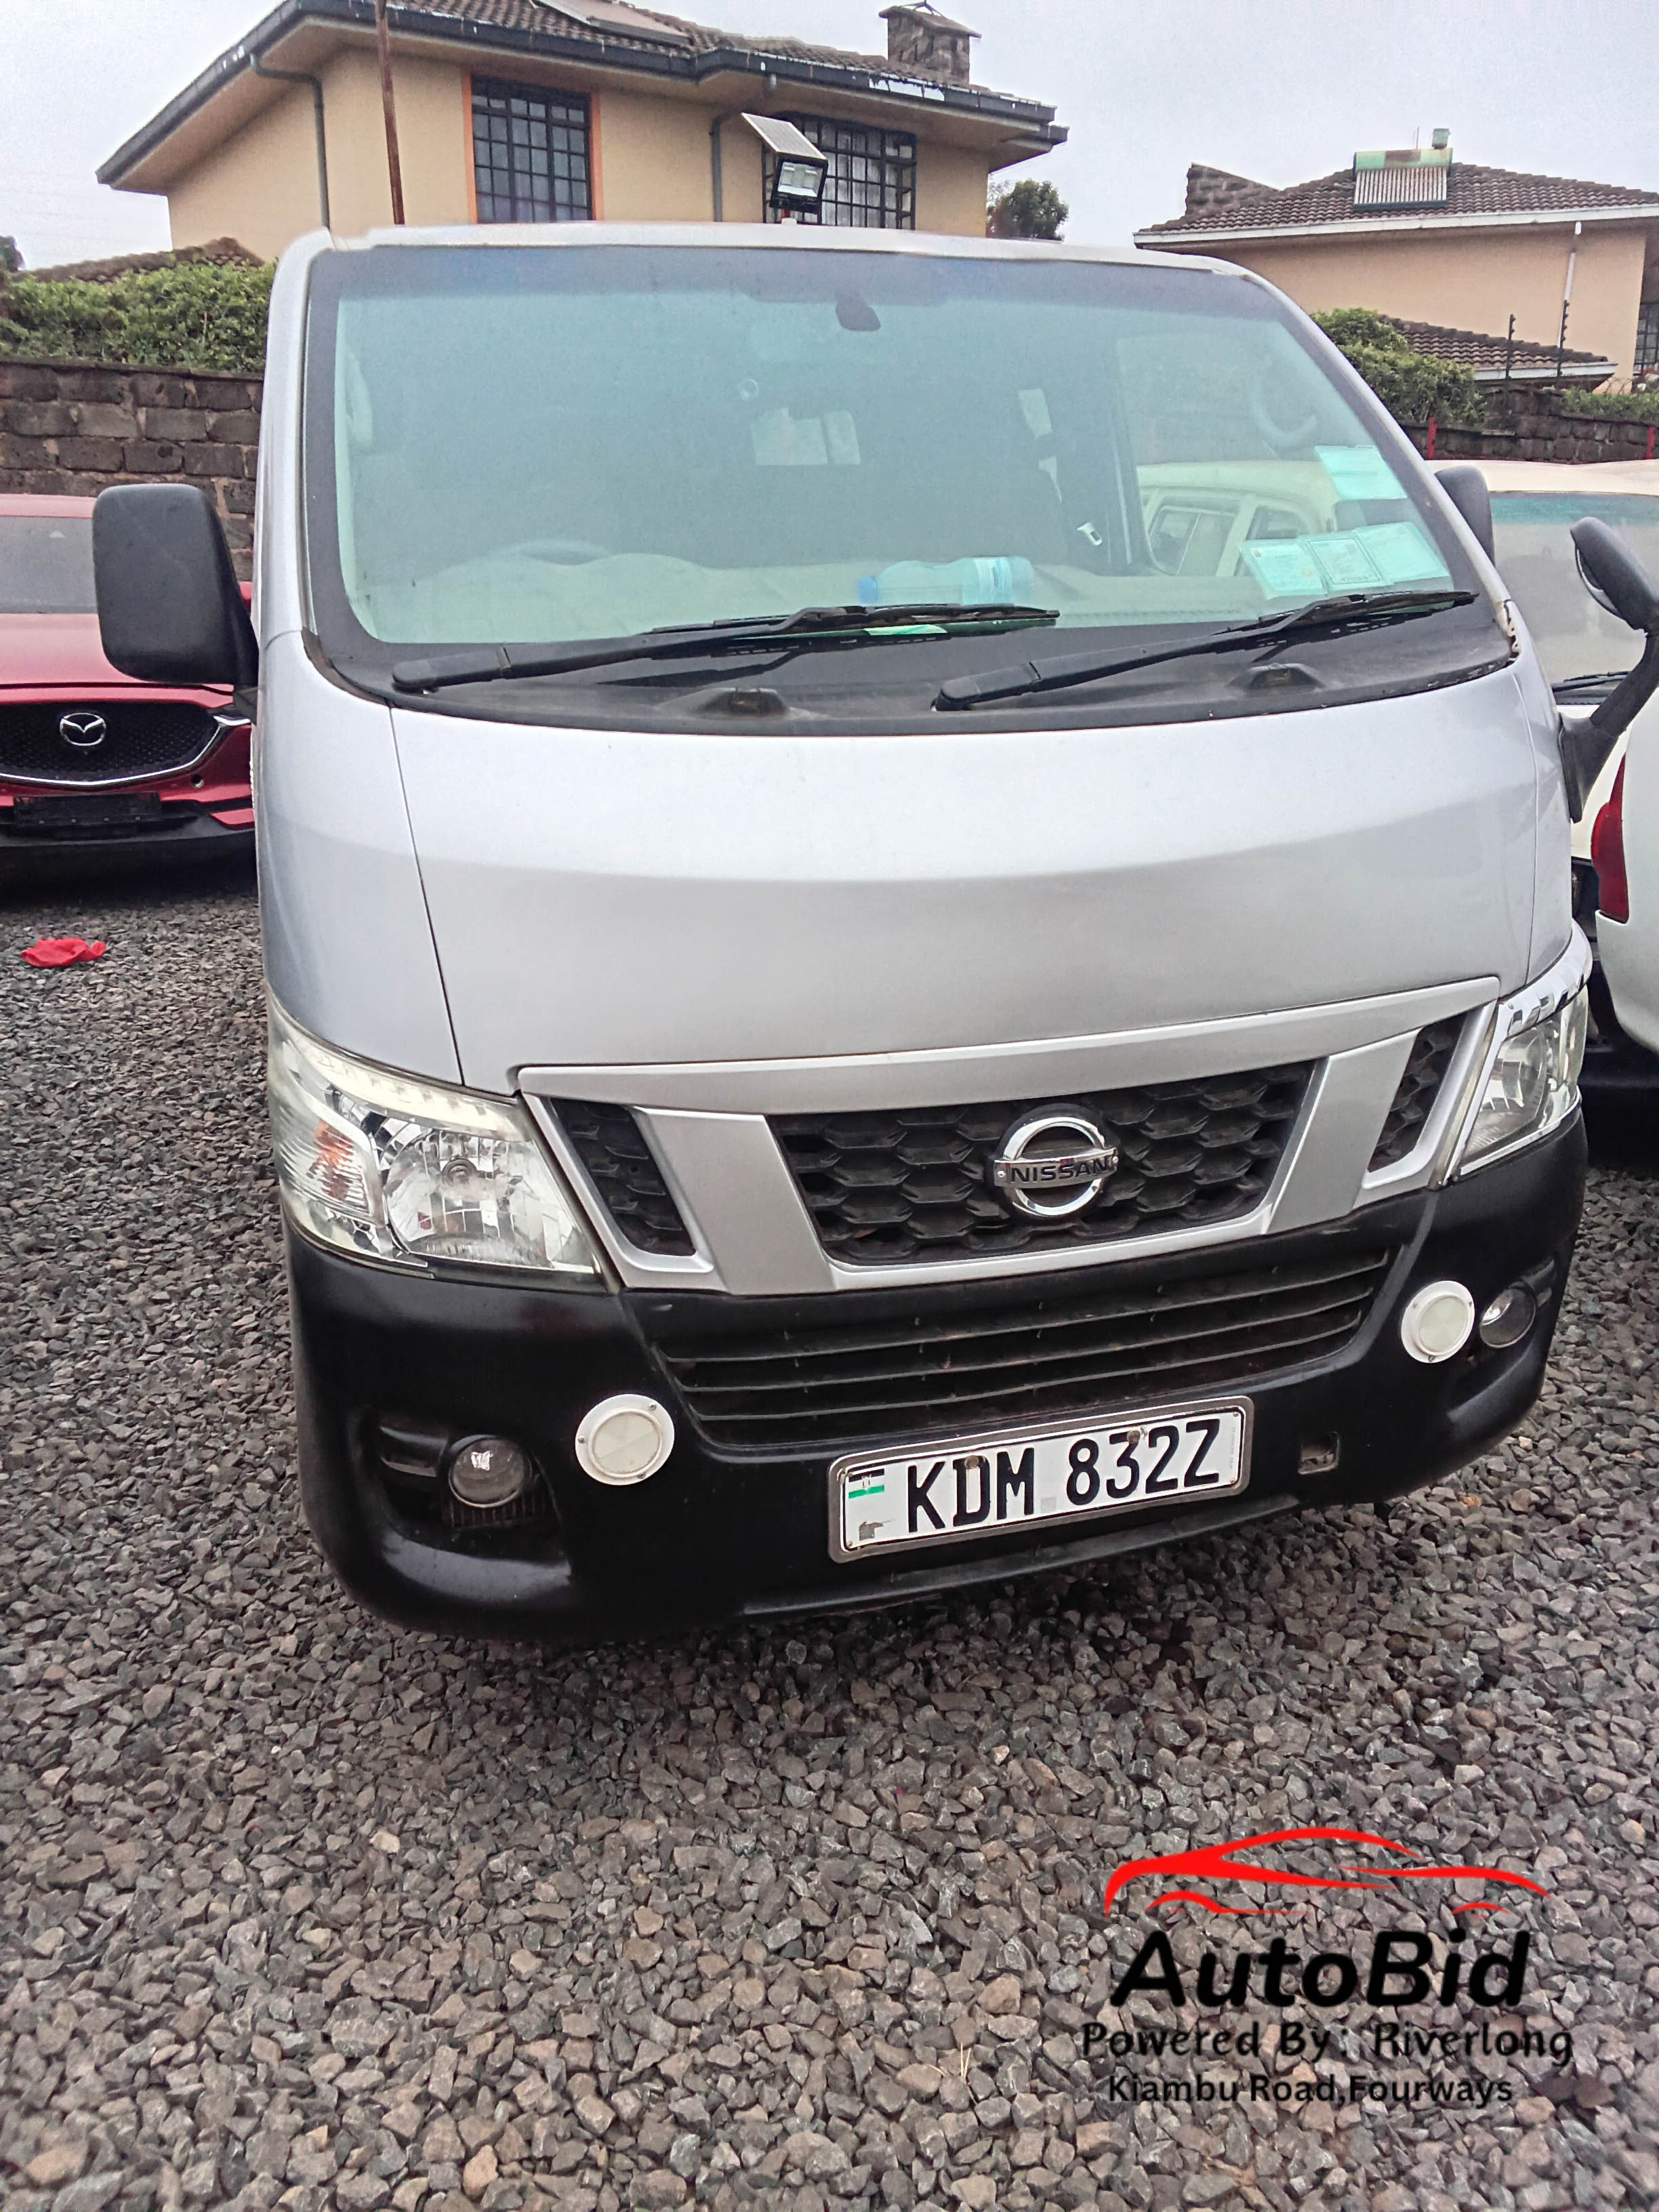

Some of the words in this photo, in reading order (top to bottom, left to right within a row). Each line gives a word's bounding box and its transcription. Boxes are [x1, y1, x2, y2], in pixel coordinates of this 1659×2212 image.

[1010, 1158, 1107, 1183] NISSAN
[907, 1448, 1034, 1533] KDM
[1066, 1418, 1221, 1506] 832Z
